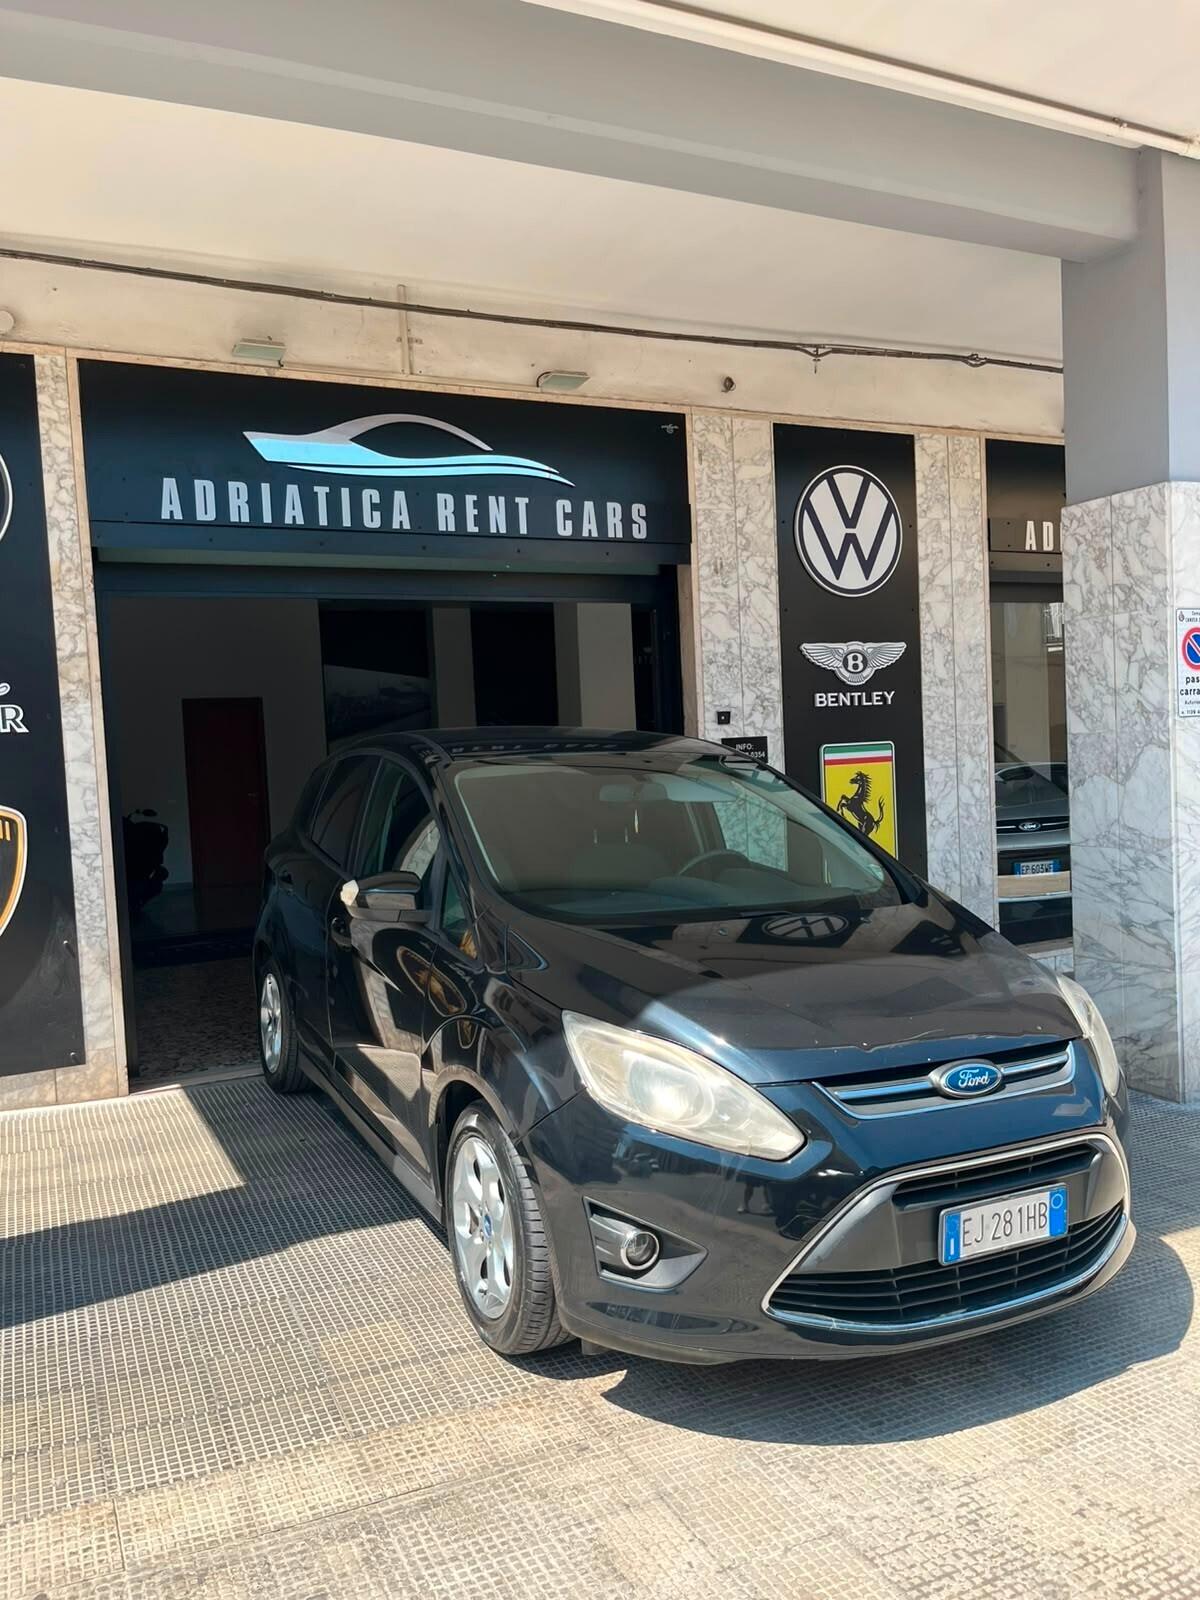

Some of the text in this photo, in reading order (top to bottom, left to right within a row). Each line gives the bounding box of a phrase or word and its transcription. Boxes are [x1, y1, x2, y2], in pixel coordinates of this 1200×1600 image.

[160, 477, 648, 540] ADRIATICA RENT CARS
[1025, 520, 1062, 551] AD
[847, 652, 864, 673] B
[814, 690, 895, 708] BENTLEY
[958, 1068, 991, 1088] Ford
[962, 1213, 984, 1247] EJ
[991, 1201, 1048, 1241] 281HB
